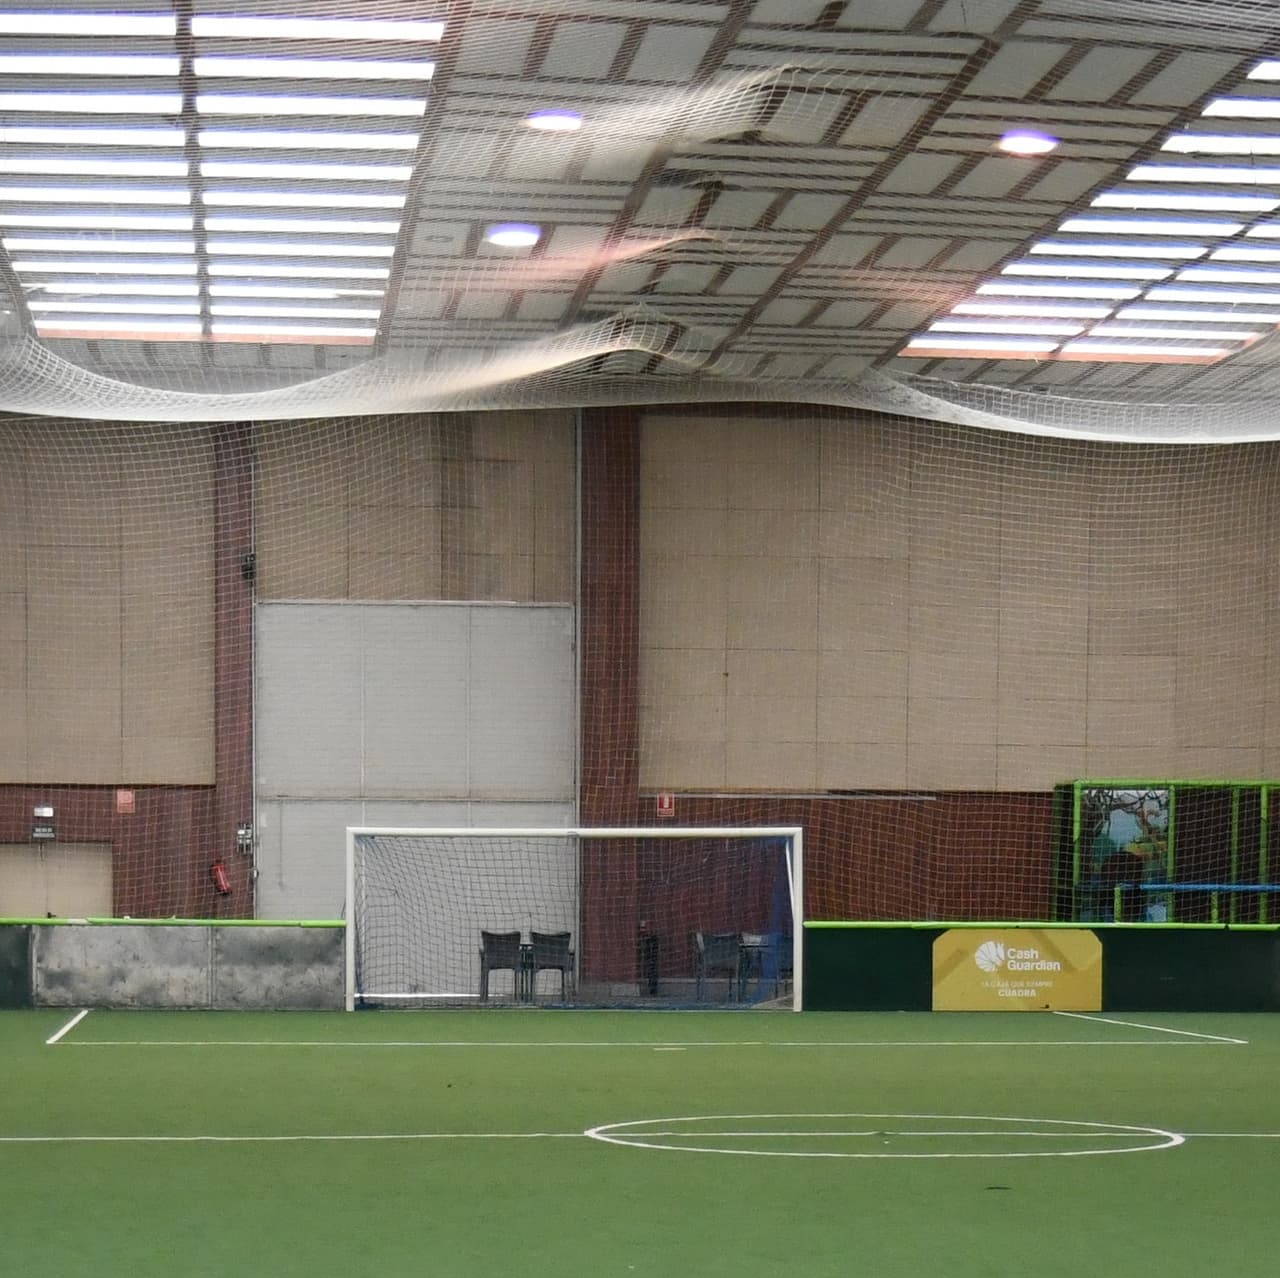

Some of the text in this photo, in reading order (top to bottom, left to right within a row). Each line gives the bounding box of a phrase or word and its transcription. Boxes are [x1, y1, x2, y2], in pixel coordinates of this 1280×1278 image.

[1007, 948, 1038, 959] Cash
[1007, 960, 1061, 971] Guardian
[998, 988, 1037, 997] CUADRA
